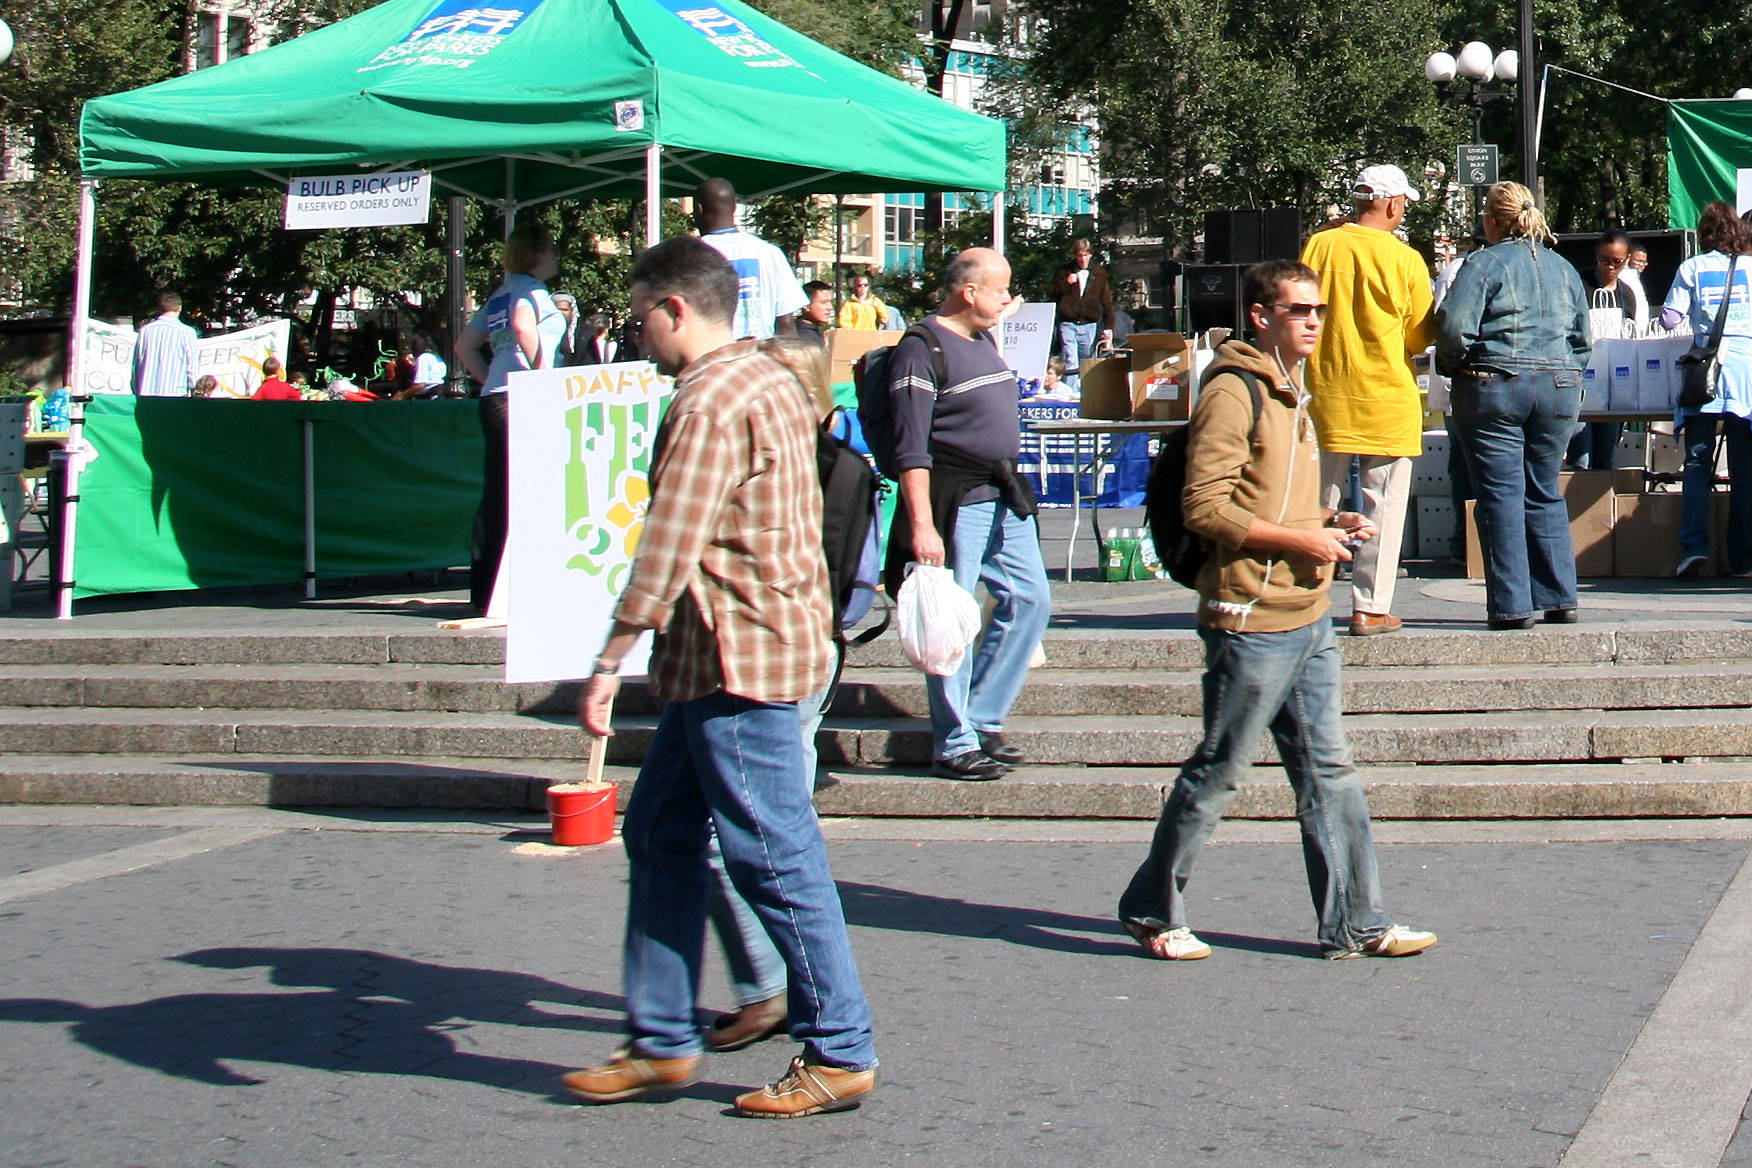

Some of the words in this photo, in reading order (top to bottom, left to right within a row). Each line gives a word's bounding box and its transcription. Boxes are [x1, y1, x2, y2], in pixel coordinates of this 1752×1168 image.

[301, 180, 345, 197] BULB
[352, 177, 392, 195] PICK
[398, 176, 420, 193] UP
[297, 200, 347, 212] RESERVED
[351, 199, 390, 210] ORDERS
[392, 197, 420, 208] ONLY
[1015, 321, 1038, 333] BAGS
[1017, 407, 1053, 420] RKERS
[1055, 407, 1078, 419] FOR
[565, 396, 671, 535] FE
